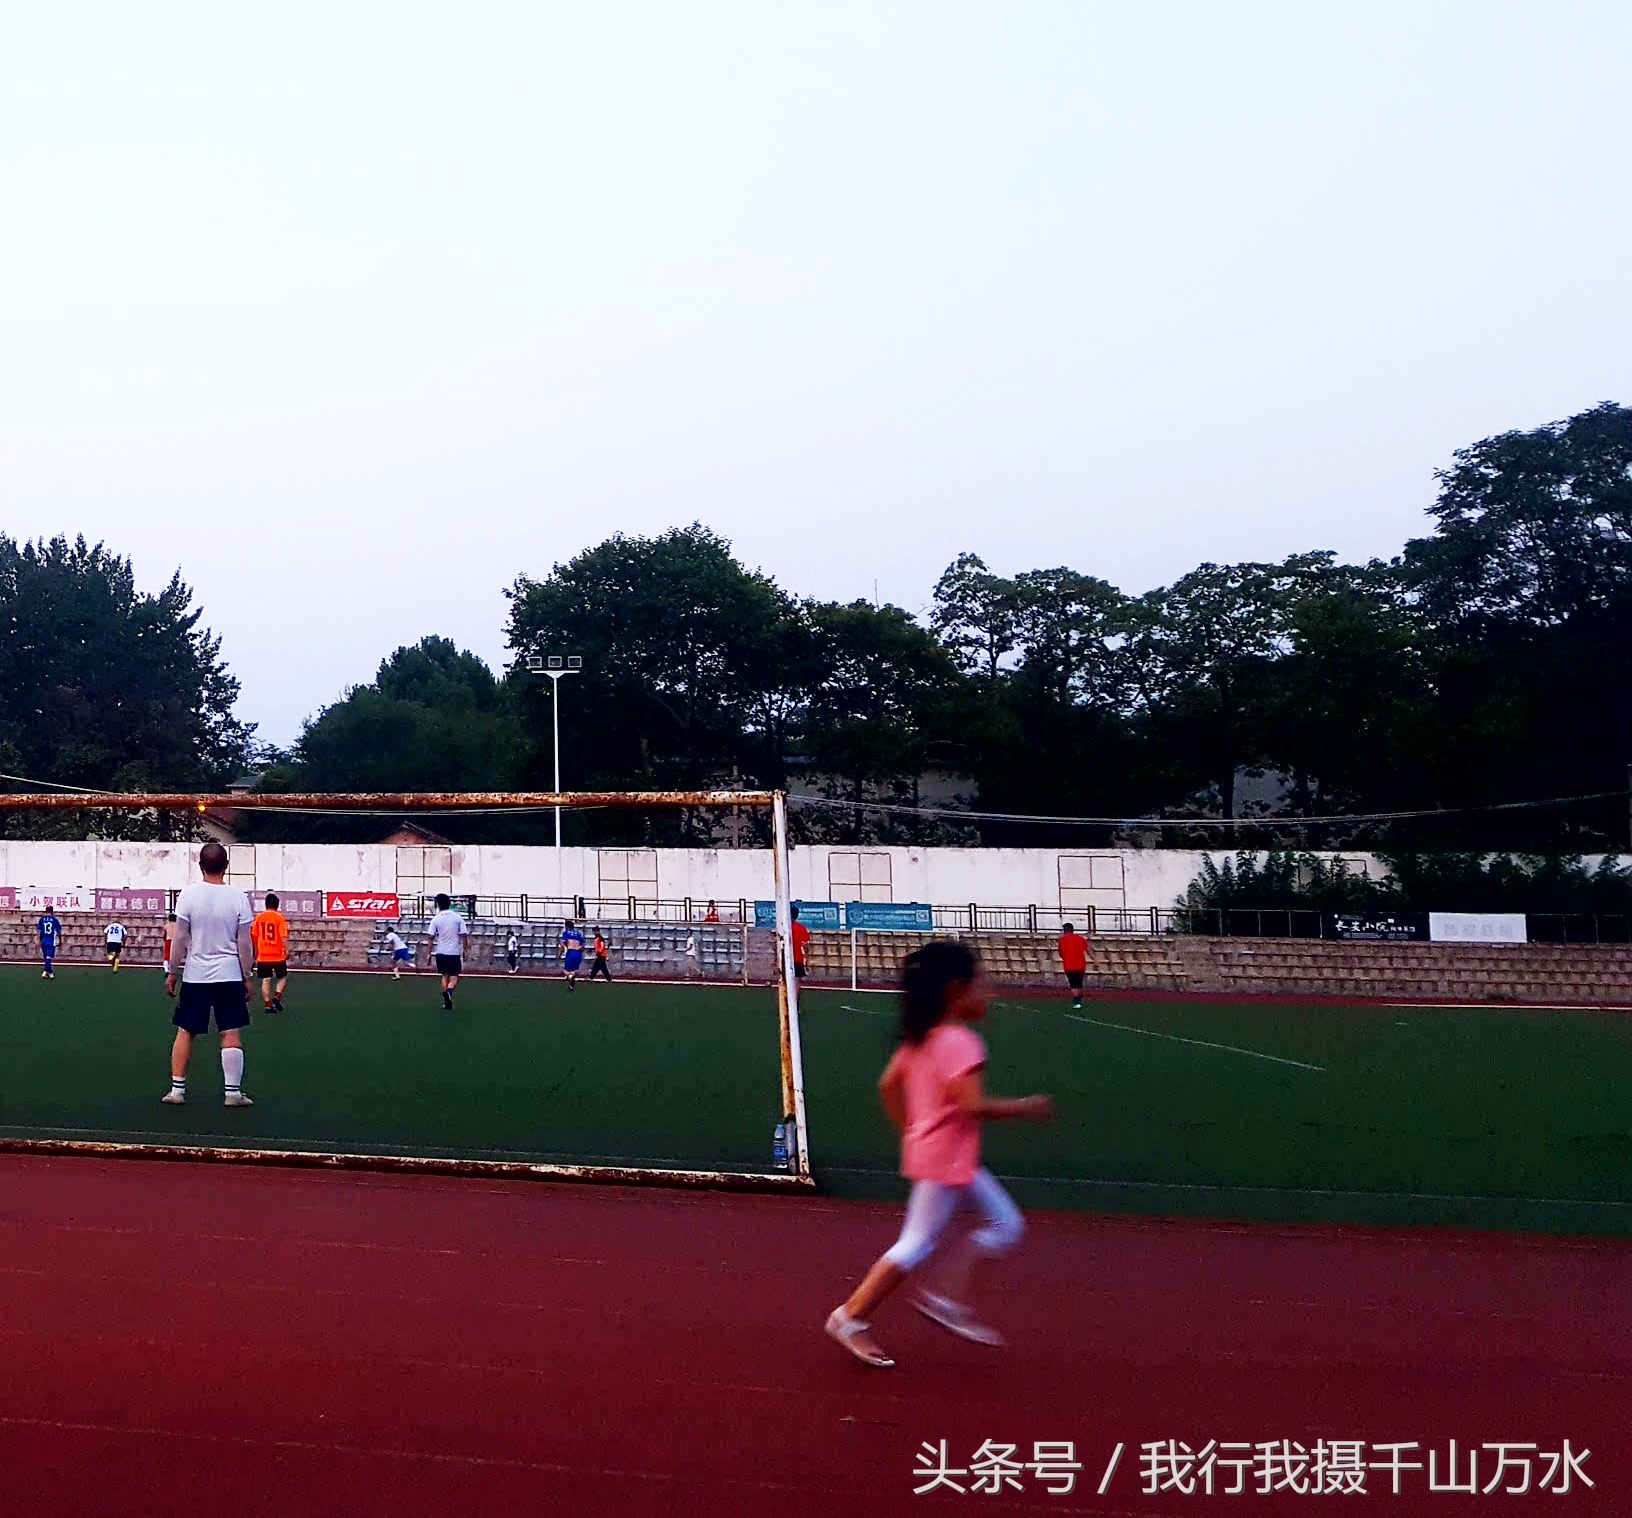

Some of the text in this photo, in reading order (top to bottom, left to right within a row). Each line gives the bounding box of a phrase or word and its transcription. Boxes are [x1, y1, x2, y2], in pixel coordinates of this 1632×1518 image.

[43, 922, 53, 935] 13
[109, 926, 119, 934] 26
[260, 922, 276, 942] 19
